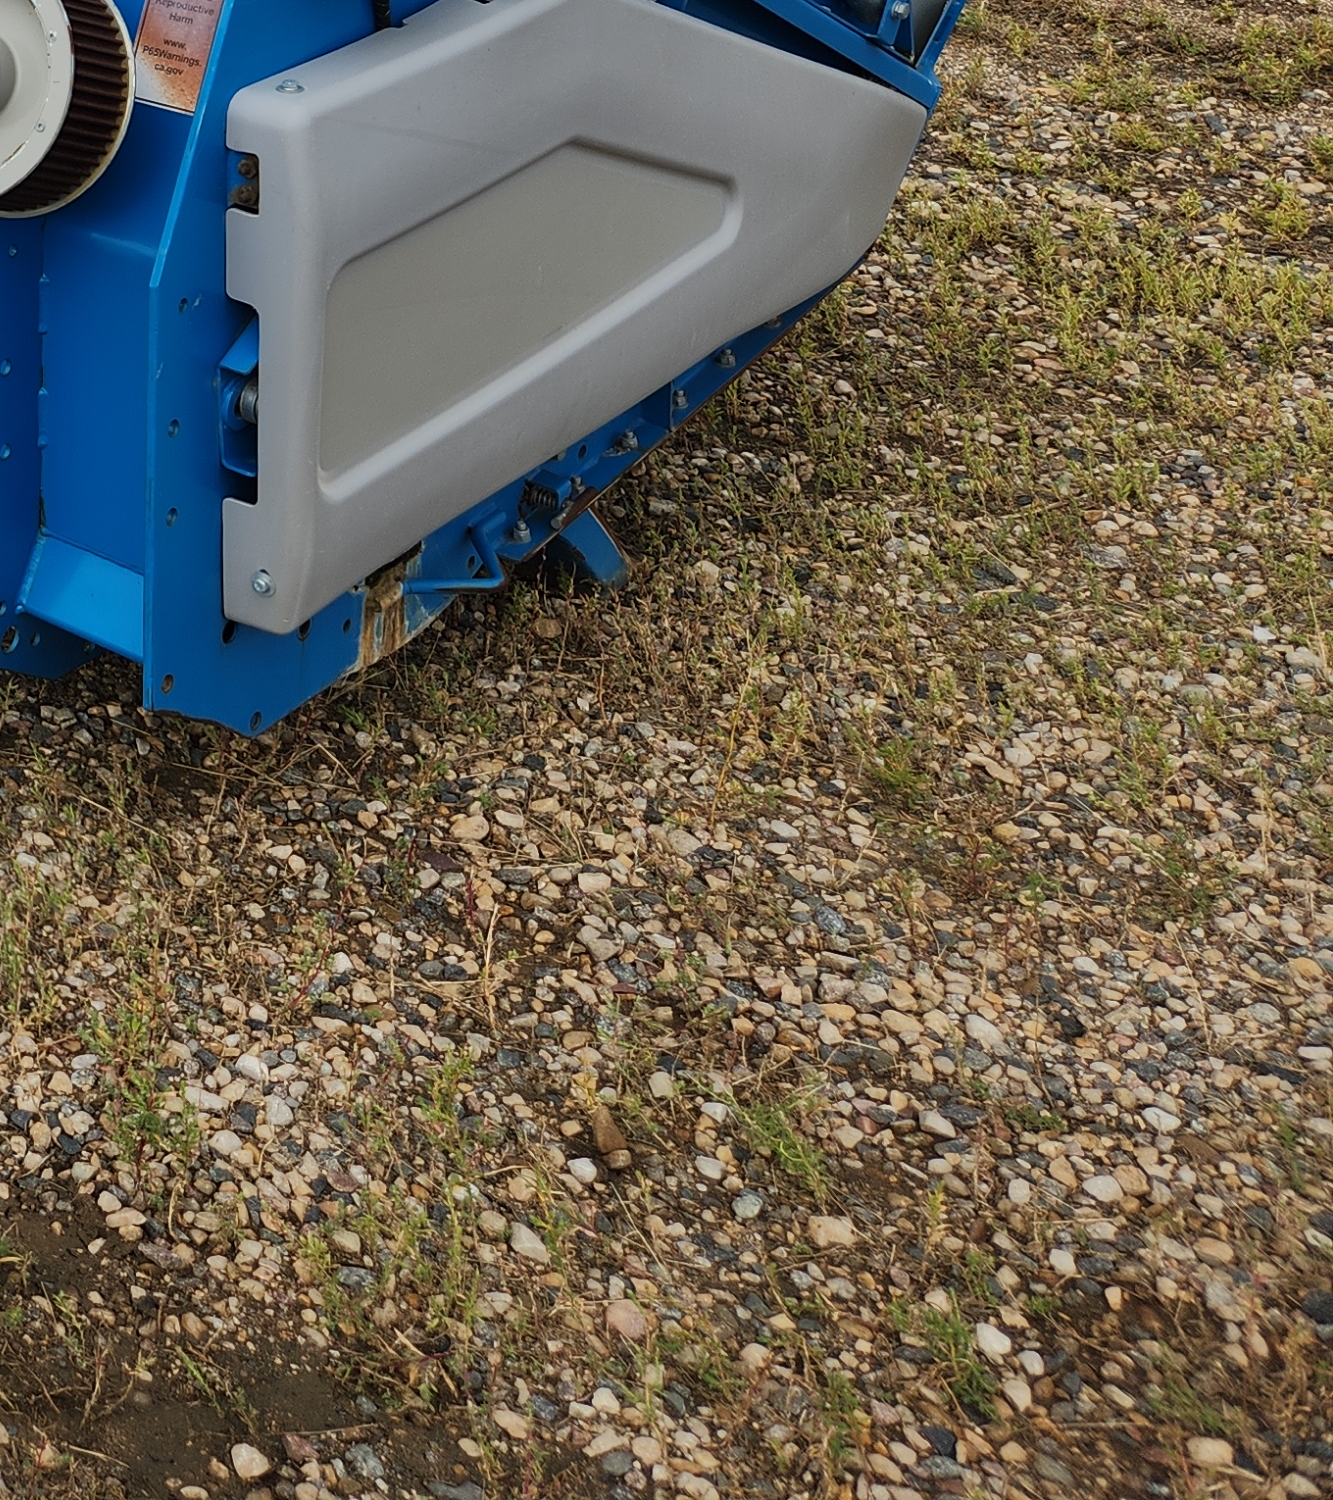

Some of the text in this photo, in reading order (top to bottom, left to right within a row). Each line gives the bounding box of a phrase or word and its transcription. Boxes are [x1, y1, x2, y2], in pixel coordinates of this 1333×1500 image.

[169, 12, 193, 25] Harm
[163, 38, 187, 51] www.
[142, 45, 202, 67] P65Warnings.
[155, 62, 184, 76] ca.gov
